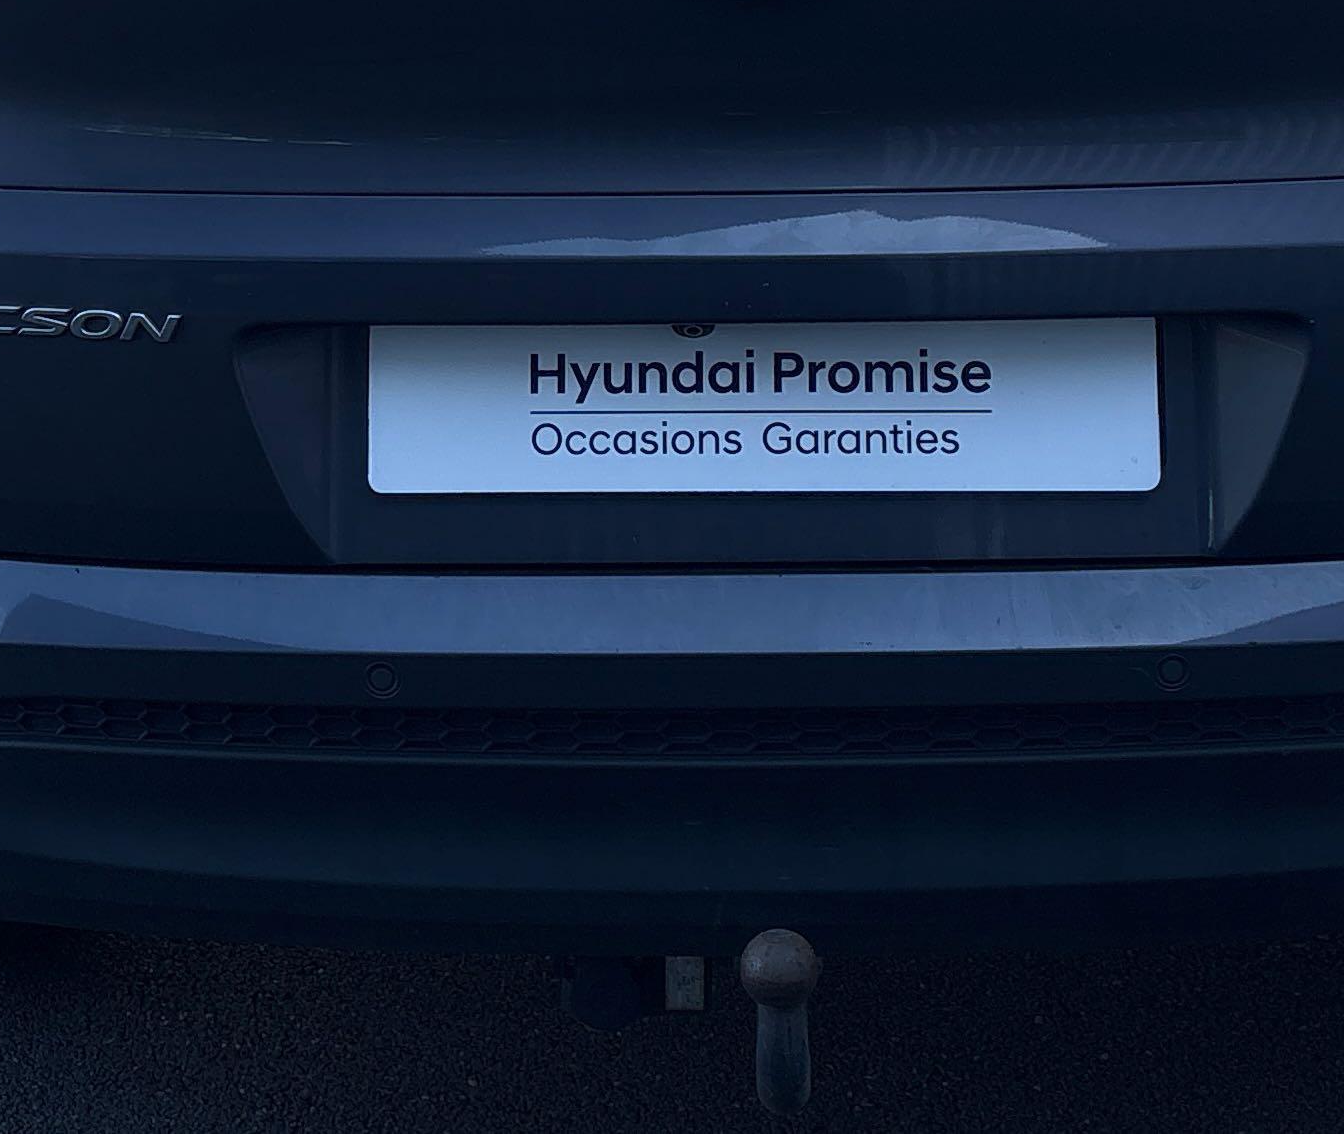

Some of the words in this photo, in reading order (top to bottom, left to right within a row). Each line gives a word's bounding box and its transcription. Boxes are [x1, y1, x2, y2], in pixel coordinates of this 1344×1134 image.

[529, 349, 755, 404] Hyundai
[773, 348, 992, 394] Promise
[531, 420, 743, 456] Occasions
[762, 419, 960, 455] Garanties
